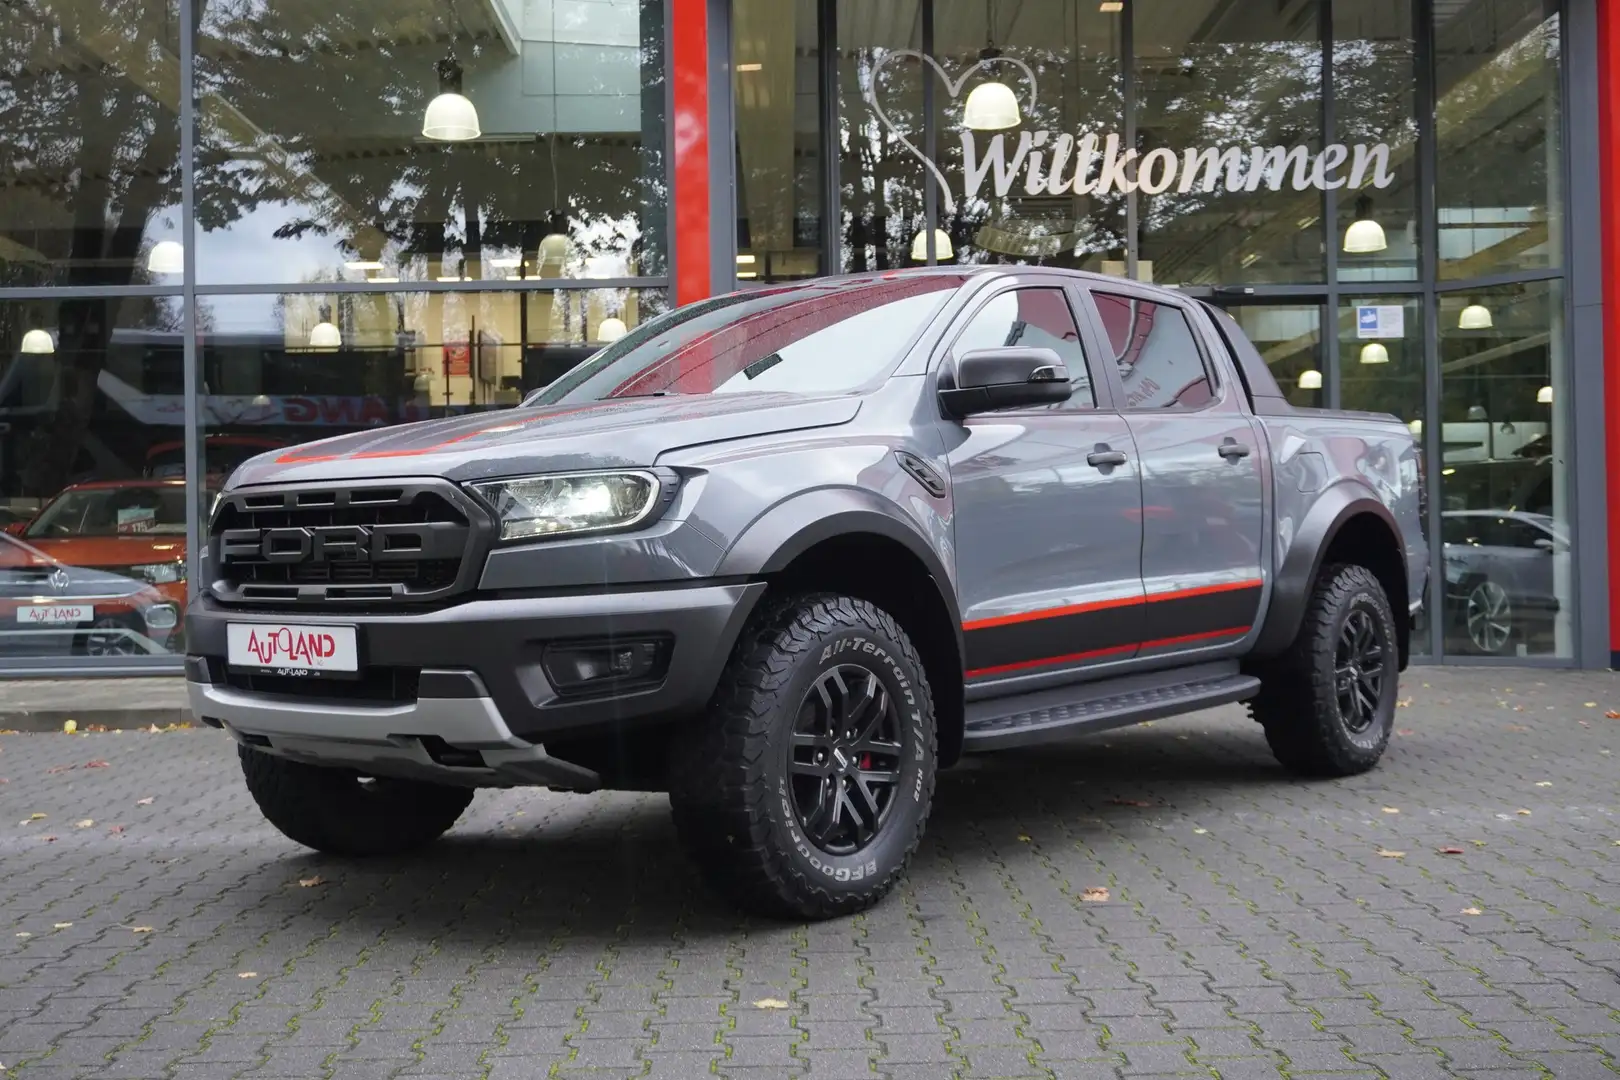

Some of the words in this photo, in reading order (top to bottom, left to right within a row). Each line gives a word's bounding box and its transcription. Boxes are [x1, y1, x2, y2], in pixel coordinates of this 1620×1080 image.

[959, 130, 1395, 198] Willkommen
[220, 523, 436, 563] FORD
[247, 627, 336, 665] AUTOLAND
[818, 636, 916, 706] All-Terrain
